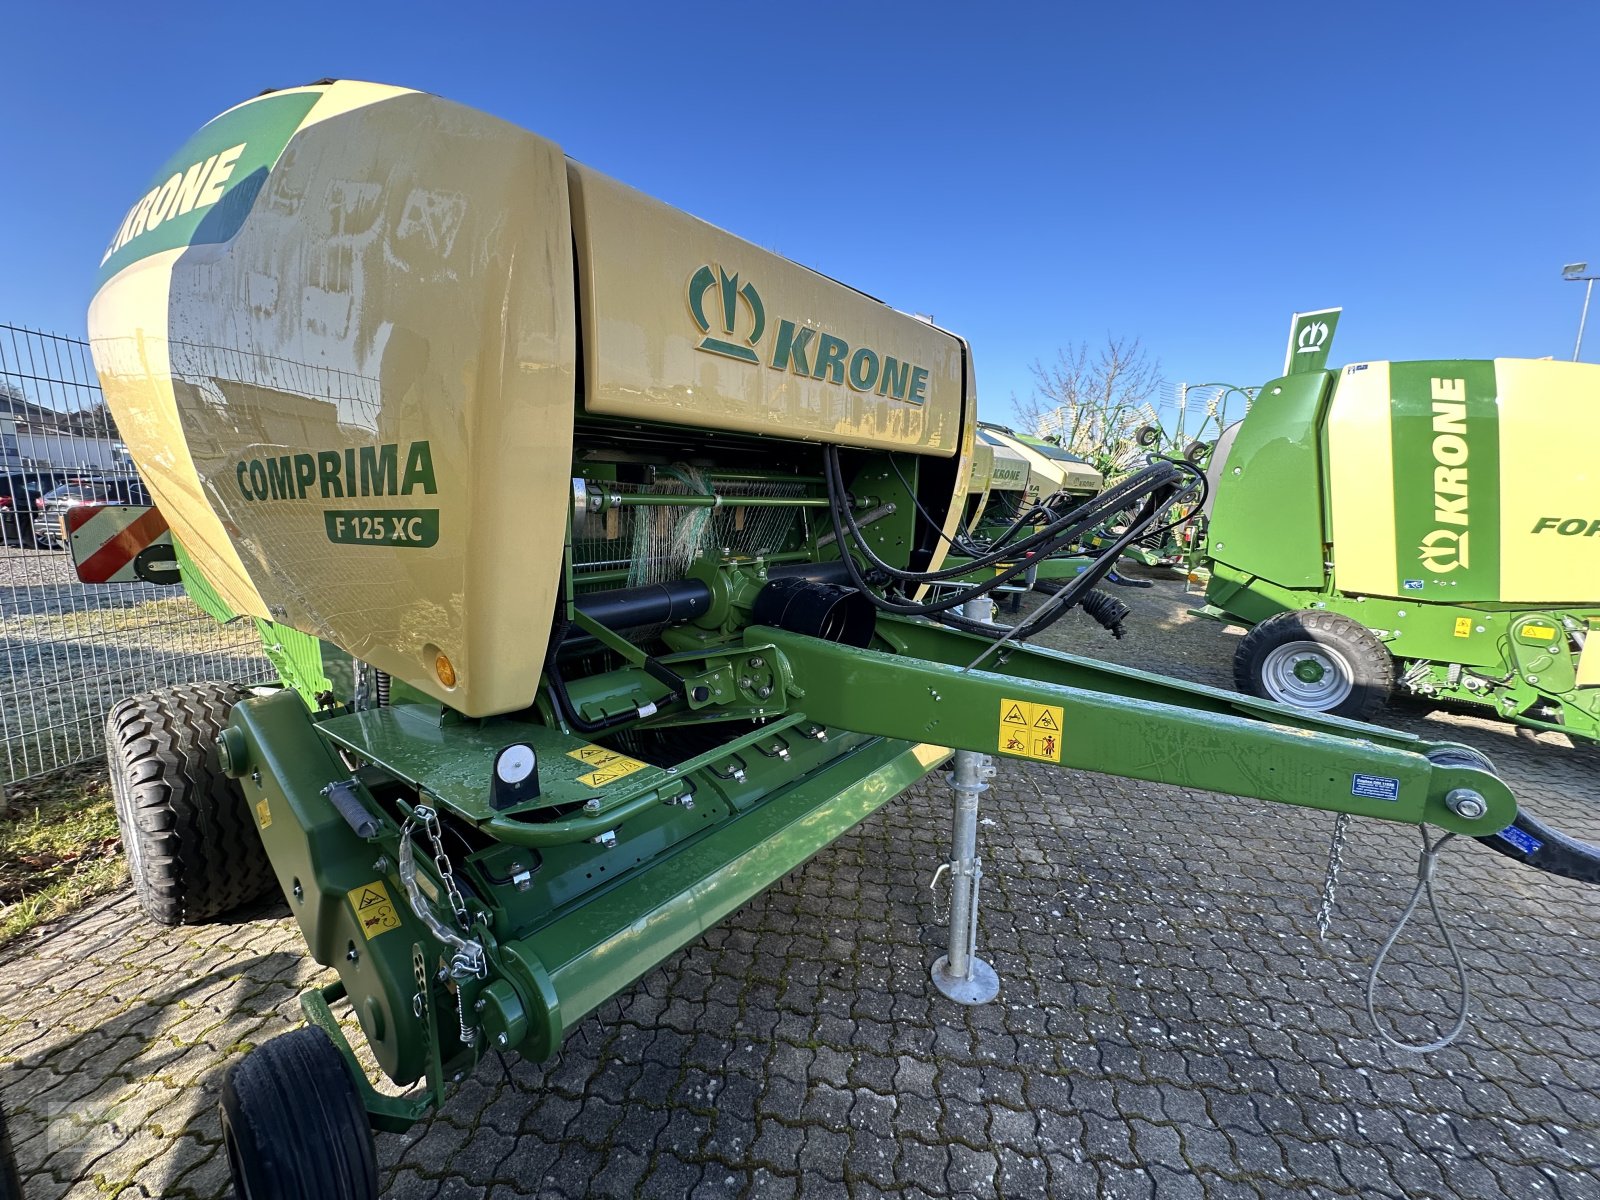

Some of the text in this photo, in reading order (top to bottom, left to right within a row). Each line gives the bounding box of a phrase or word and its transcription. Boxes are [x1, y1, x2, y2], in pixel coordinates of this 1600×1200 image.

[112, 142, 247, 254] KRONE
[770, 318, 929, 406] KRONE
[236, 440, 438, 502] COMPRIMA
[992, 468, 1021, 480] KRONE
[1431, 378, 1469, 526] KRONE
[335, 517, 422, 541] F 125 XC
